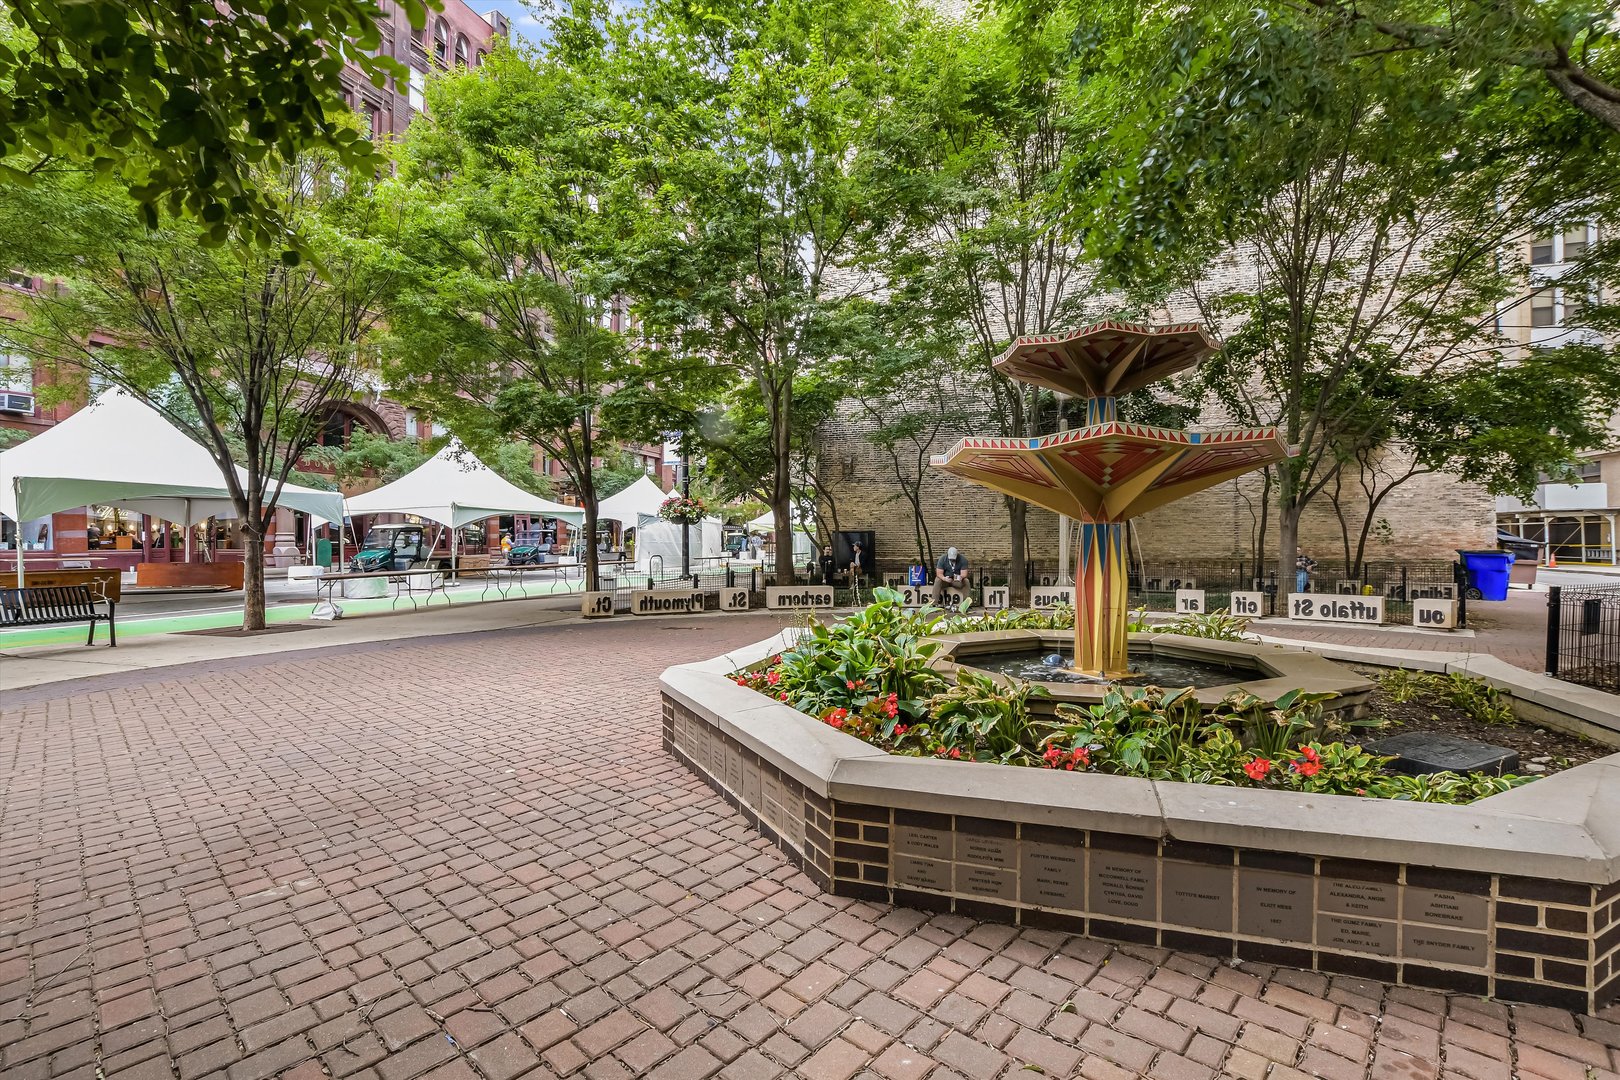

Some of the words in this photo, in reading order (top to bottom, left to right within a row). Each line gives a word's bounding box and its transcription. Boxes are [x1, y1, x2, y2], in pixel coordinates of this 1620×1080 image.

[1198, 893, 1221, 901] MARKET
[1434, 893, 1456, 901] PASHA
[1430, 902, 1460, 911] ASHTIANI
[1424, 912, 1464, 921] BONEBRAKE
[1426, 940, 1451, 949] SNYDER
[1452, 944, 1476, 952] FAMILY
